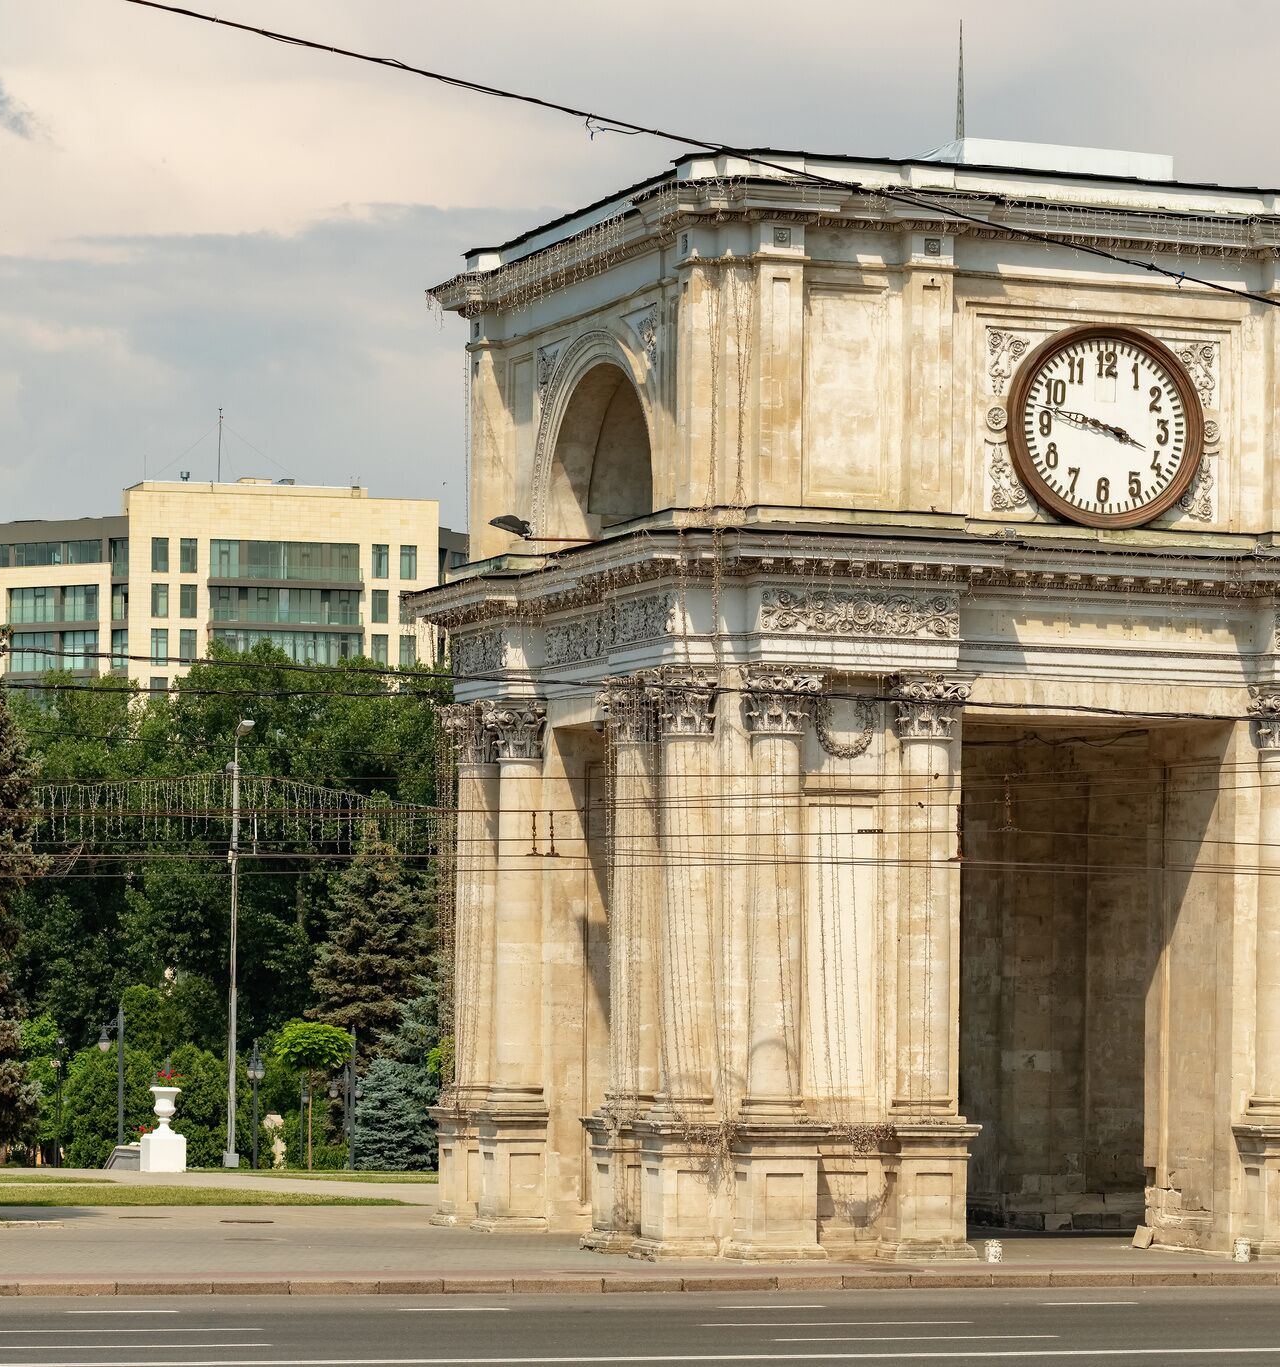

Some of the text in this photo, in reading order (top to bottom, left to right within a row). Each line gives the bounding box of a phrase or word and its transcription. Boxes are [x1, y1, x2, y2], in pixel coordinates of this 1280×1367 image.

[1068, 357, 1084, 384] 11
[1097, 351, 1118, 378] 12
[1131, 363, 1141, 390] 1
[1045, 378, 1066, 406] 10
[1148, 386, 1163, 412] 2
[1038, 411, 1053, 436] 9
[1156, 419, 1170, 445] 3
[1045, 442, 1059, 469] 8
[1150, 451, 1163, 476] 4
[1068, 467, 1081, 494] 7
[1096, 477, 1110, 503] 6
[1128, 472, 1141, 497] 5
